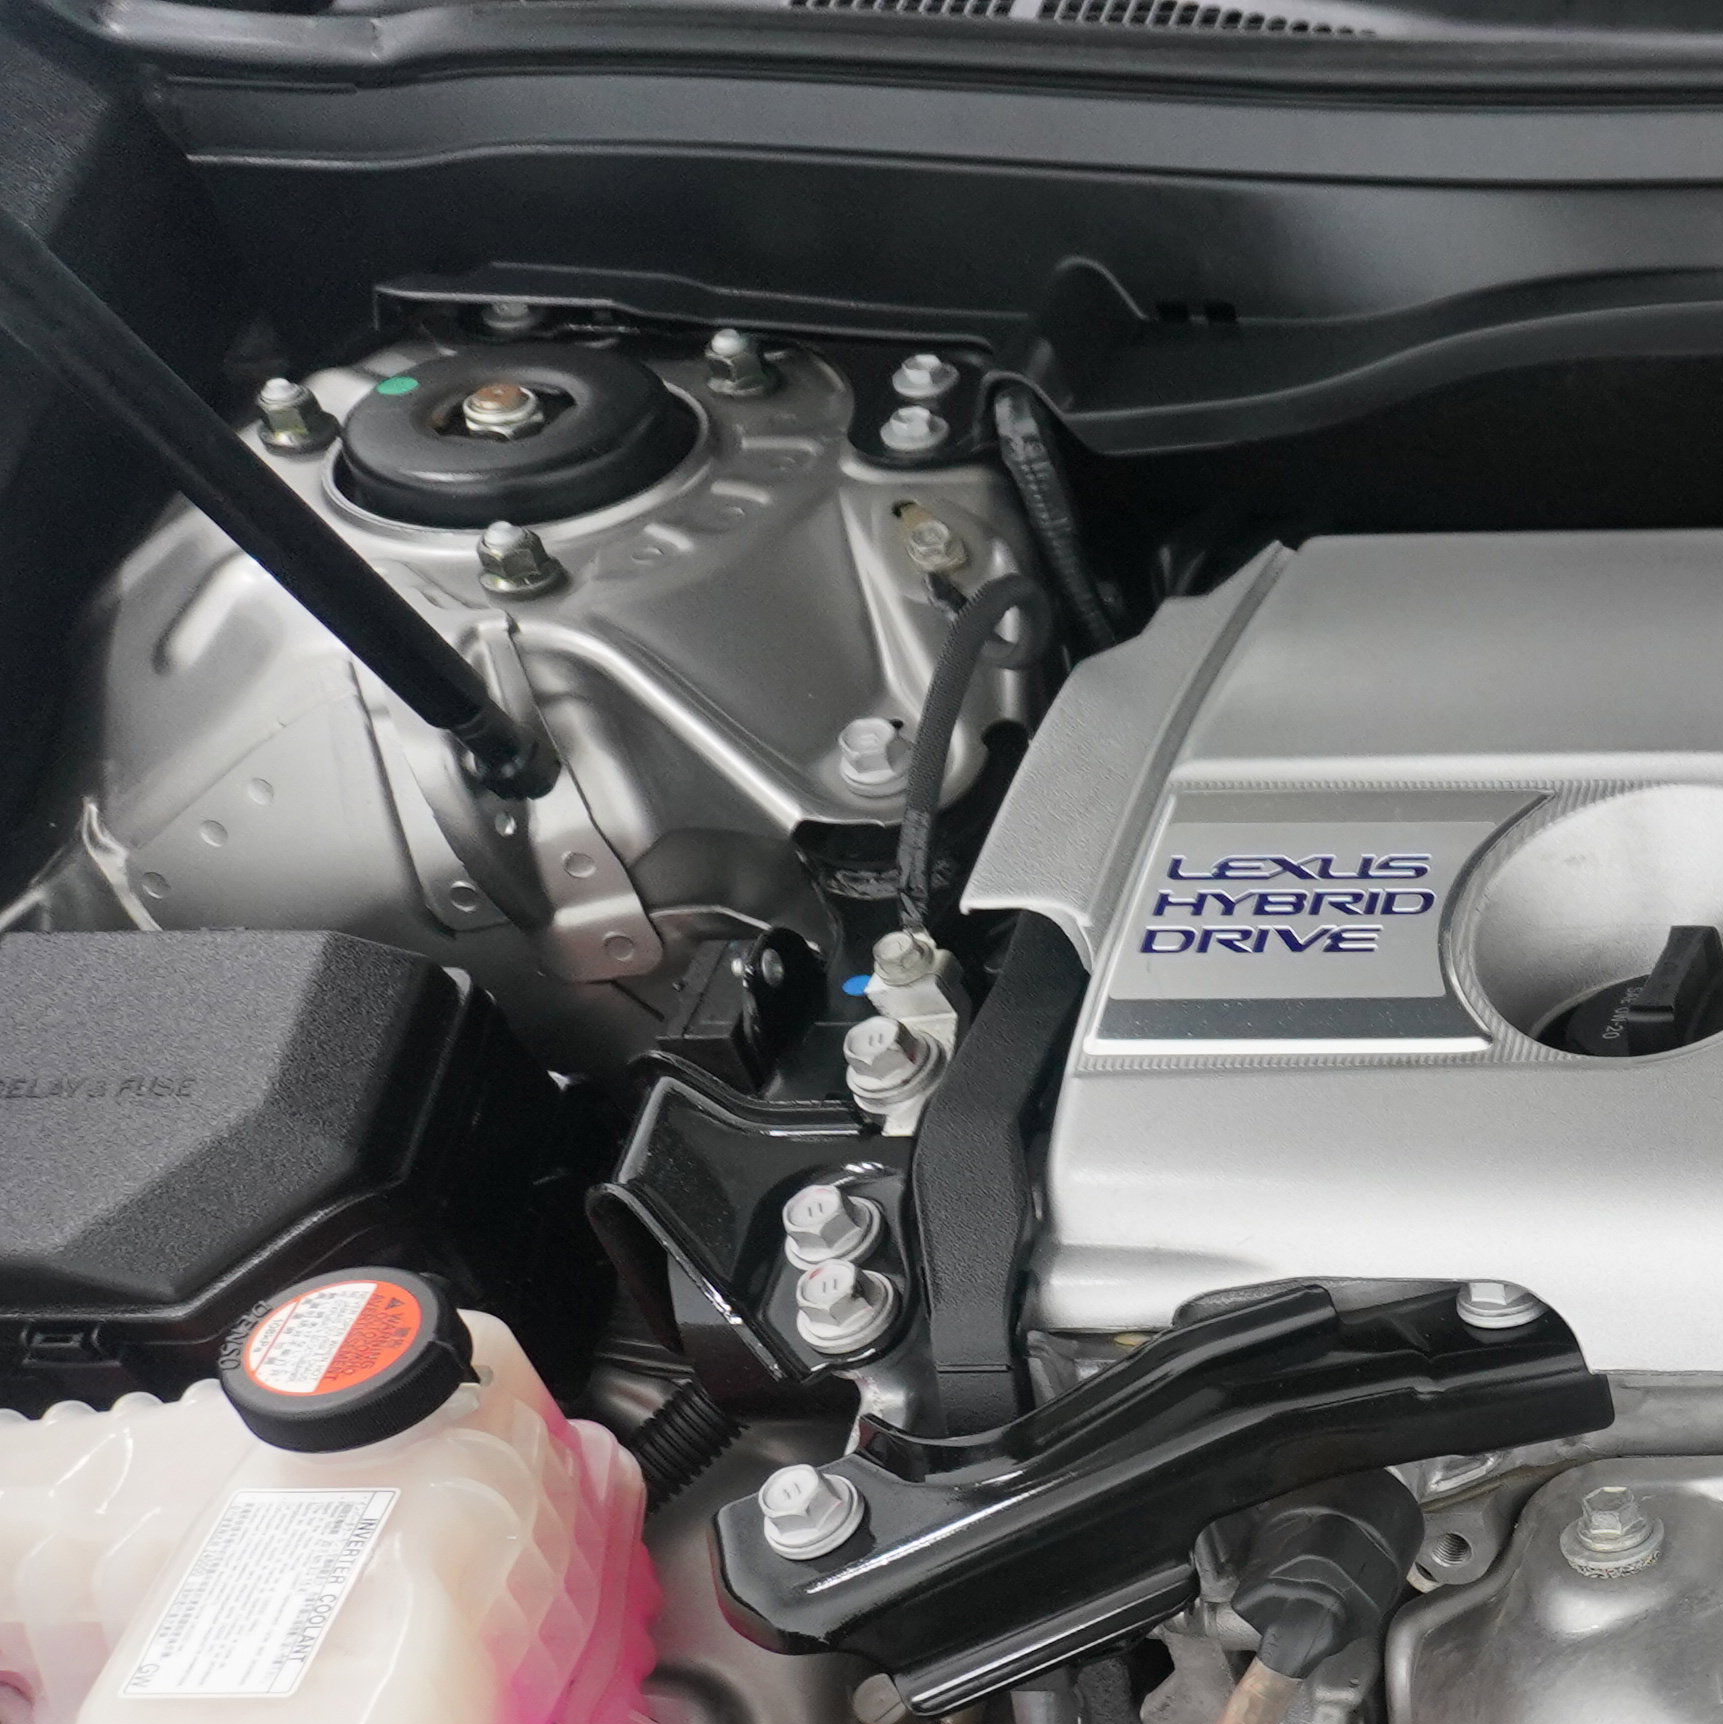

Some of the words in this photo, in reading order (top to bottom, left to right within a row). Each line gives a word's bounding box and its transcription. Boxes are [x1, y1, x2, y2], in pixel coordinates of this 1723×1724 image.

[1167, 853, 1432, 880] LEXUS
[1152, 888, 1437, 916] HYBRID
[1139, 924, 1385, 954] DRIVE
[218, 1300, 272, 1371] DENSO
[361, 1312, 404, 1370] WARNING
[327, 1517, 378, 1585] INVERTER
[286, 1593, 337, 1664] COOLANT
